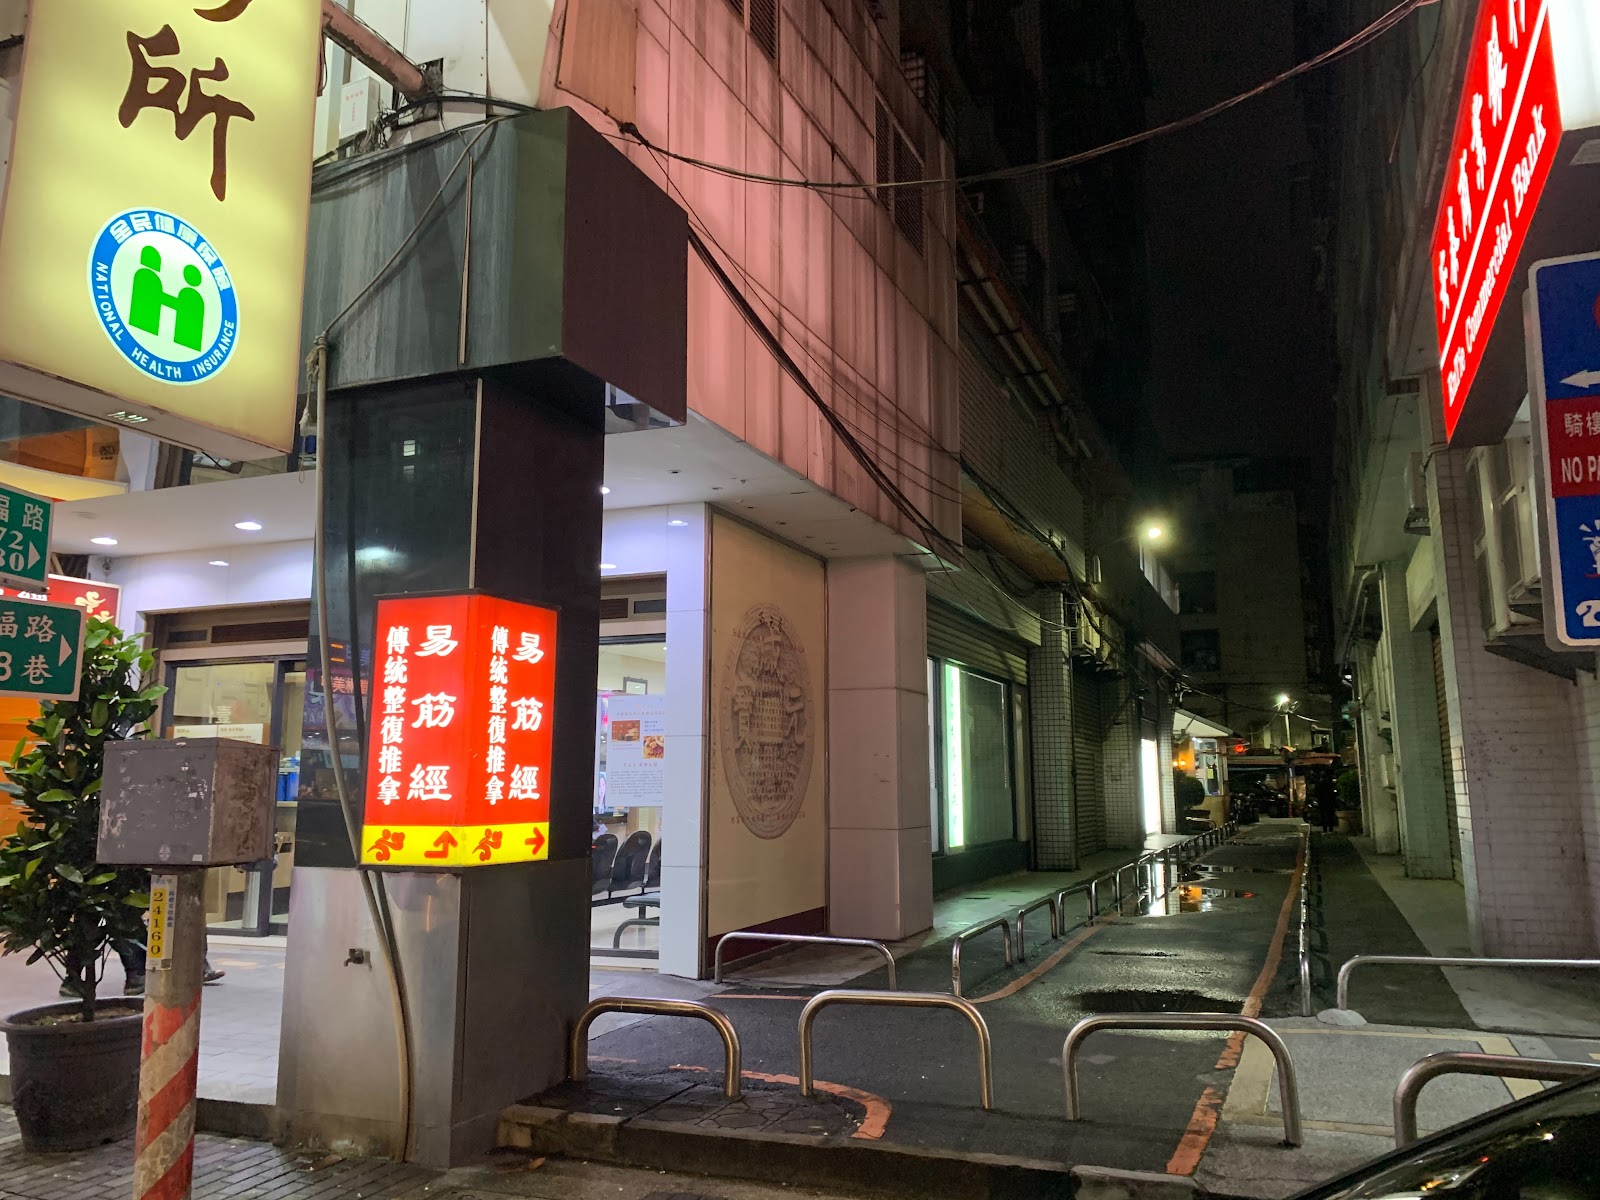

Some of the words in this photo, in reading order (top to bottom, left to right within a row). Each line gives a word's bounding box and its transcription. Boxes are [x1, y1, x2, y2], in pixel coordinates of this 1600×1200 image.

[118, 0, 255, 202] 所
[109, 212, 231, 291] 全民健康保險
[1465, 198, 1512, 353] Commercial
[1511, 104, 1546, 218] Bank
[95, 261, 123, 342] NATIONAL
[131, 346, 183, 379] HEALTH
[192, 319, 235, 378] INSURANCE
[1561, 456, 1583, 483] NO
[1587, 455, 1600, 482] P
[376, 625, 410, 805] 傳統整復推拿
[407, 624, 459, 801] 易筋經
[484, 625, 510, 805] 傳統整復推拿
[508, 632, 545, 801] 易筋經
[150, 891, 164, 955] 24160
